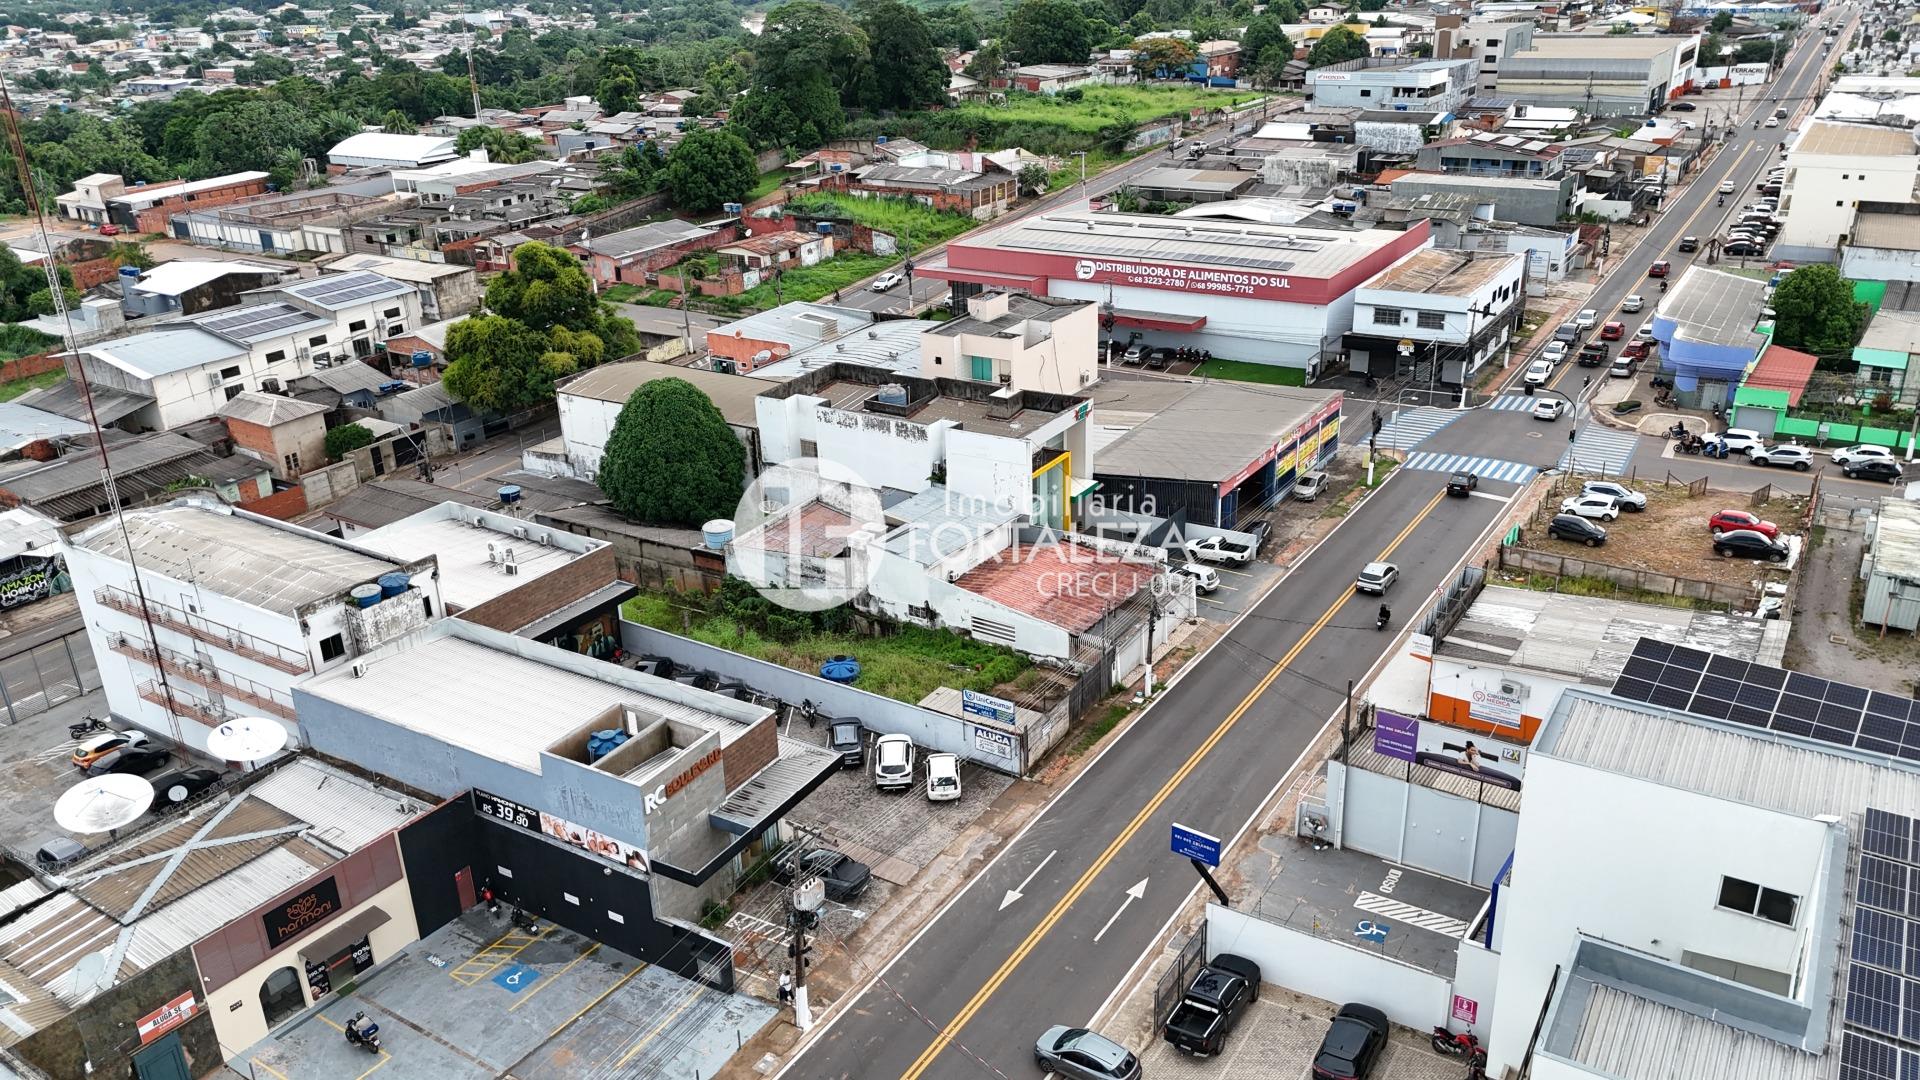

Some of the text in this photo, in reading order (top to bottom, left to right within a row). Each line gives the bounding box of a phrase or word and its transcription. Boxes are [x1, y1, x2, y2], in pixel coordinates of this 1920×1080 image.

[1096, 261, 1171, 278] DISTRIBUIDORA
[1173, 269, 1187, 279] DE
[1188, 270, 1249, 285] ALIMENTOS
[1250, 276, 1268, 287] DO
[1270, 277, 1291, 289] SUL
[1134, 276, 1143, 284] 68
[1143, 275, 1185, 288] 3223-2780
[1197, 281, 1206, 290] 68
[1206, 281, 1254, 294] 99985-7712
[1, 571, 45, 593] AMAZON
[975, 693, 1011, 710] UniCesumar
[976, 729, 1010, 746] ALUGA
[1503, 747, 1520, 762] 12X
[644, 746, 723, 815] RC BOULEVARD
[1379, 868, 1403, 894] IDOSO
